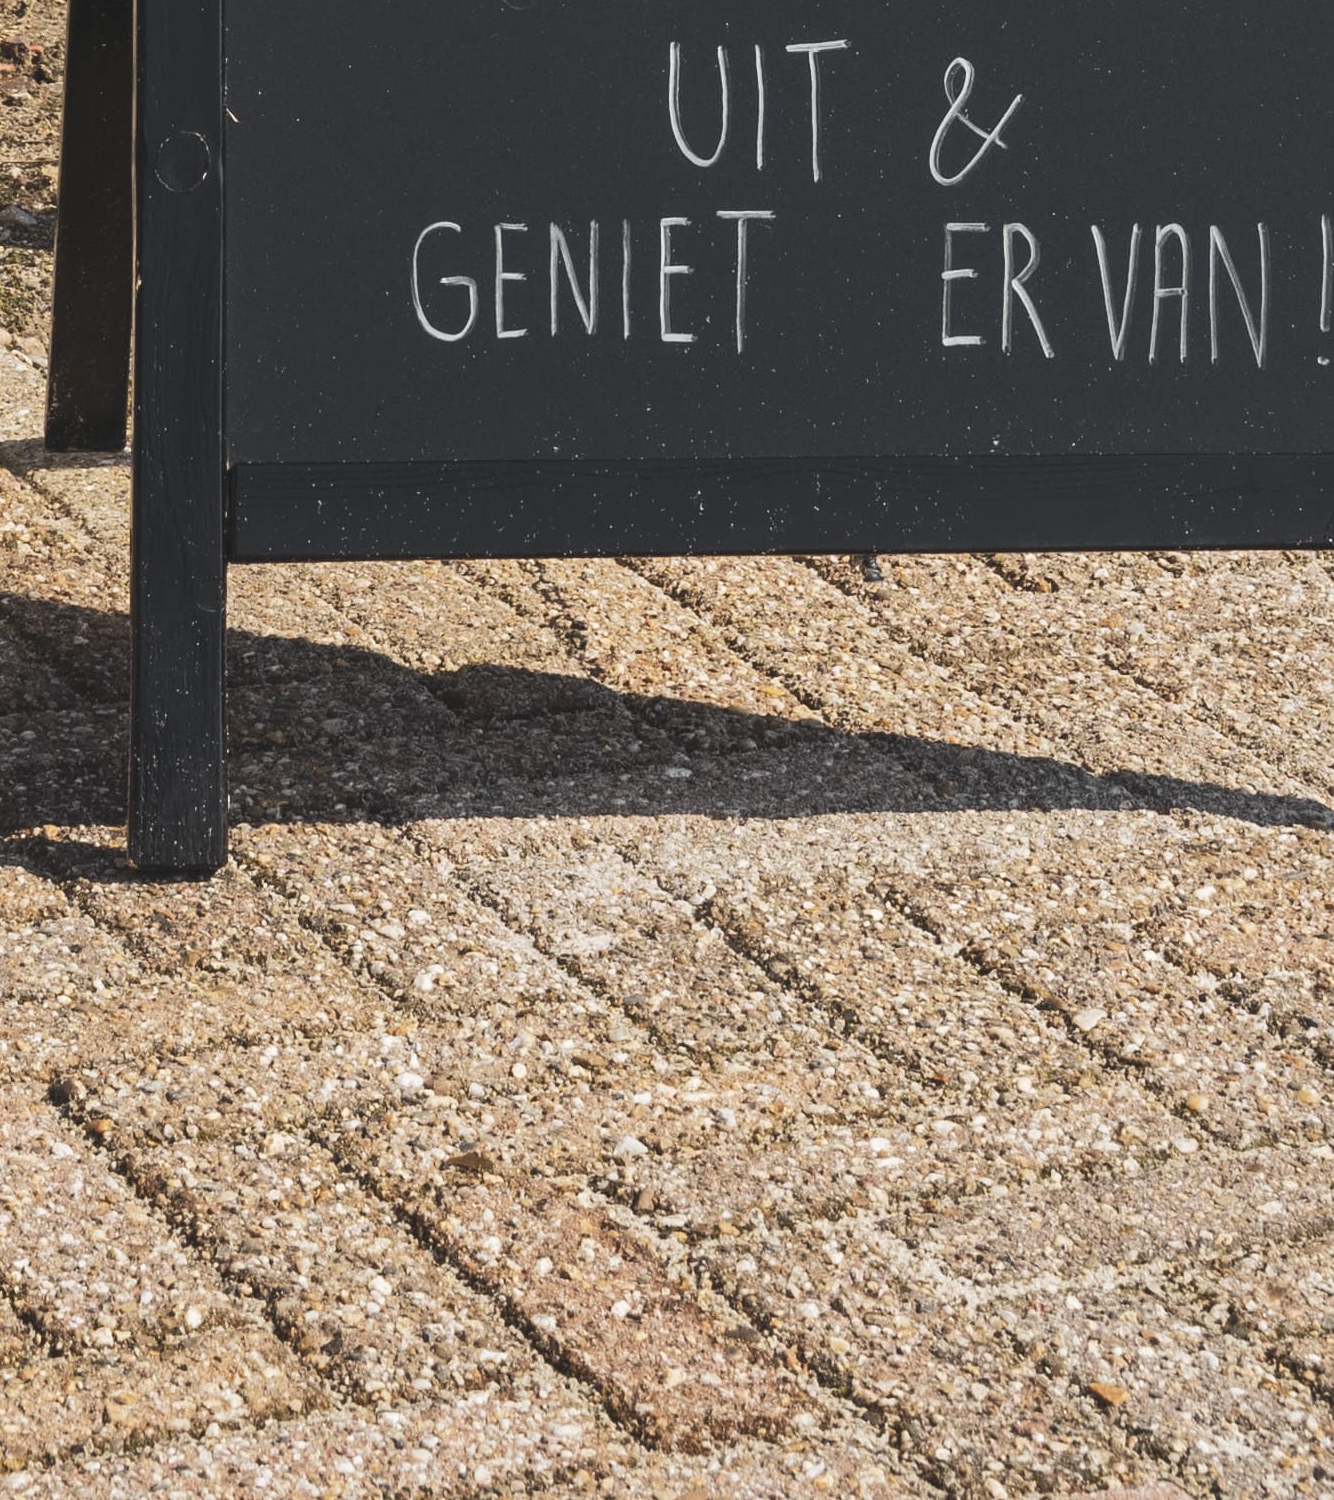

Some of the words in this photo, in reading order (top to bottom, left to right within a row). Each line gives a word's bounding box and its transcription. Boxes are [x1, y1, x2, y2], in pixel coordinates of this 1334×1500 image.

[669, 39, 852, 183] UIT
[928, 56, 1023, 186] &
[409, 208, 776, 353] GENIET
[939, 221, 1054, 358] ER
